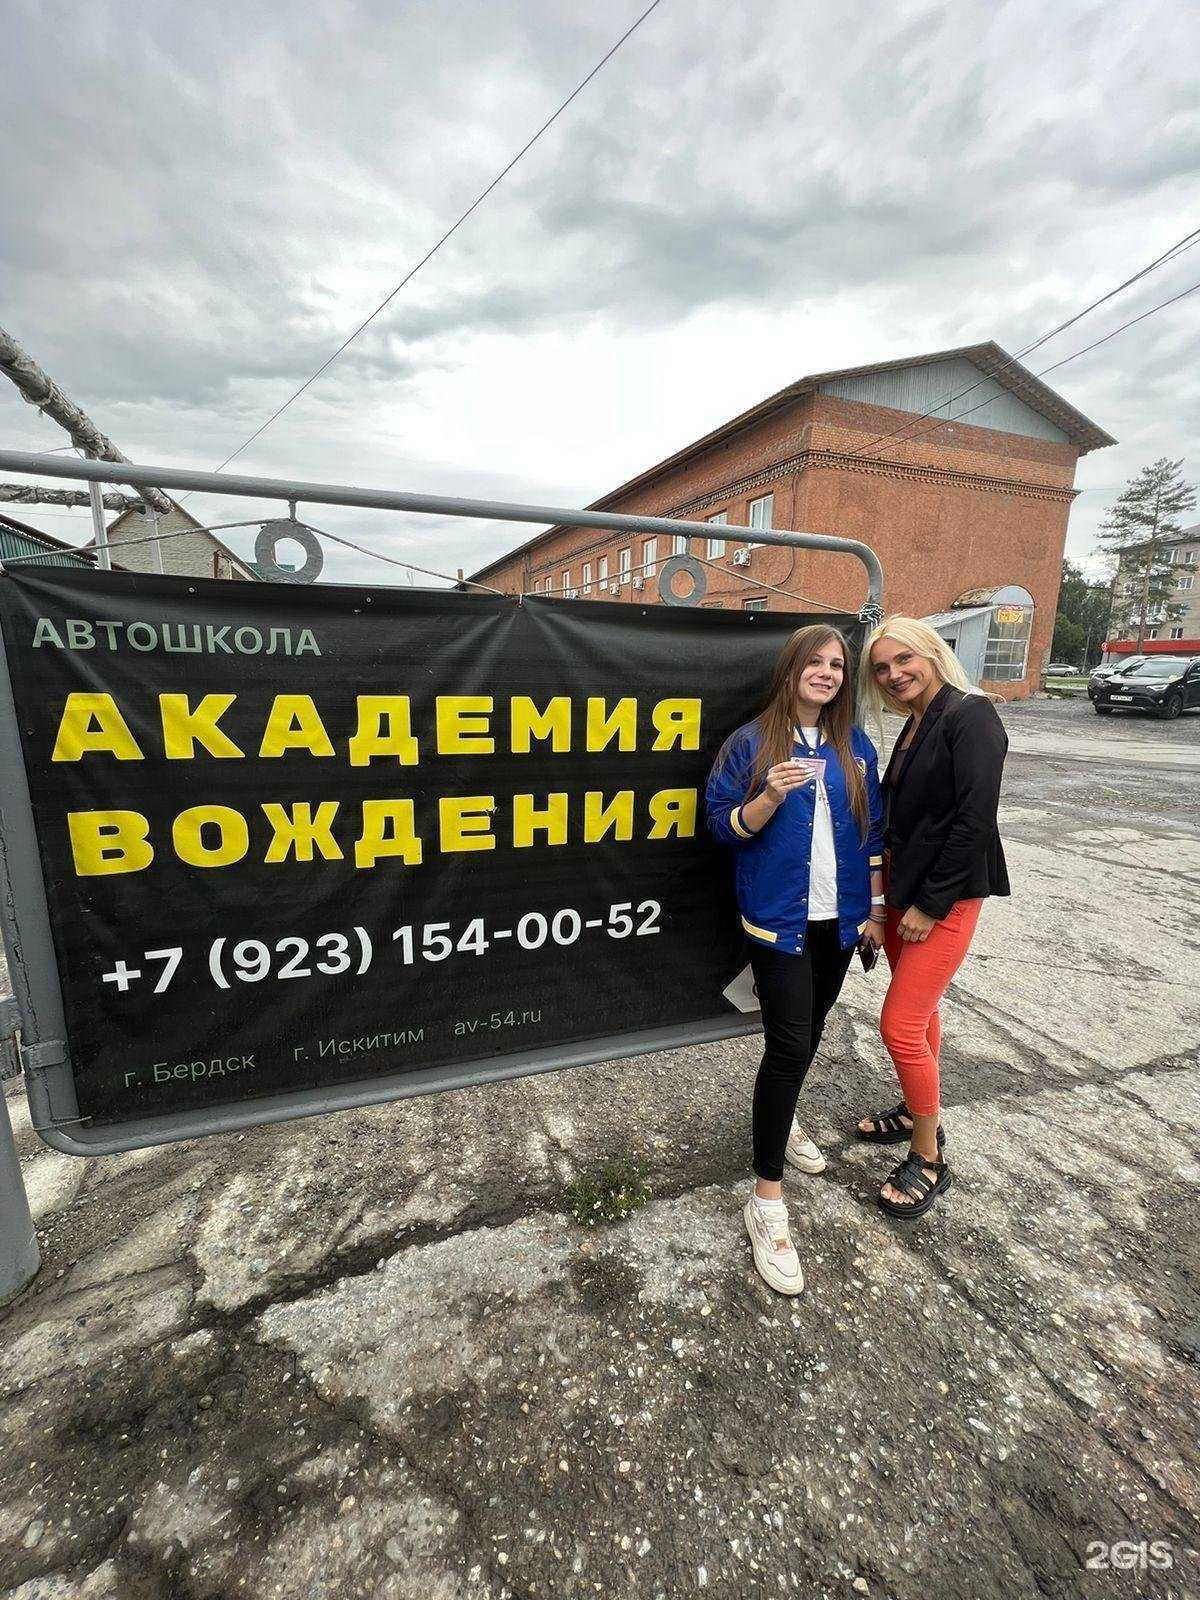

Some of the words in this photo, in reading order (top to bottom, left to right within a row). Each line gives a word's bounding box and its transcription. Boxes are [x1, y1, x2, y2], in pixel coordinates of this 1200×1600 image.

[32, 617, 322, 656] АВТОШКОЛА
[51, 692, 703, 767] АКАДЕМИЯ
[67, 788, 698, 877] ВОЖДЕНИЯ
[102, 946, 184, 994] +7
[208, 926, 374, 989] (923)
[392, 899, 662, 965] 154-00-52
[454, 1008, 542, 1037] av-54.ru
[123, 1069, 143, 1088] г.
[153, 1053, 256, 1083] Бердск
[292, 1046, 310, 1063] г.
[318, 1027, 425, 1057] Искитим
